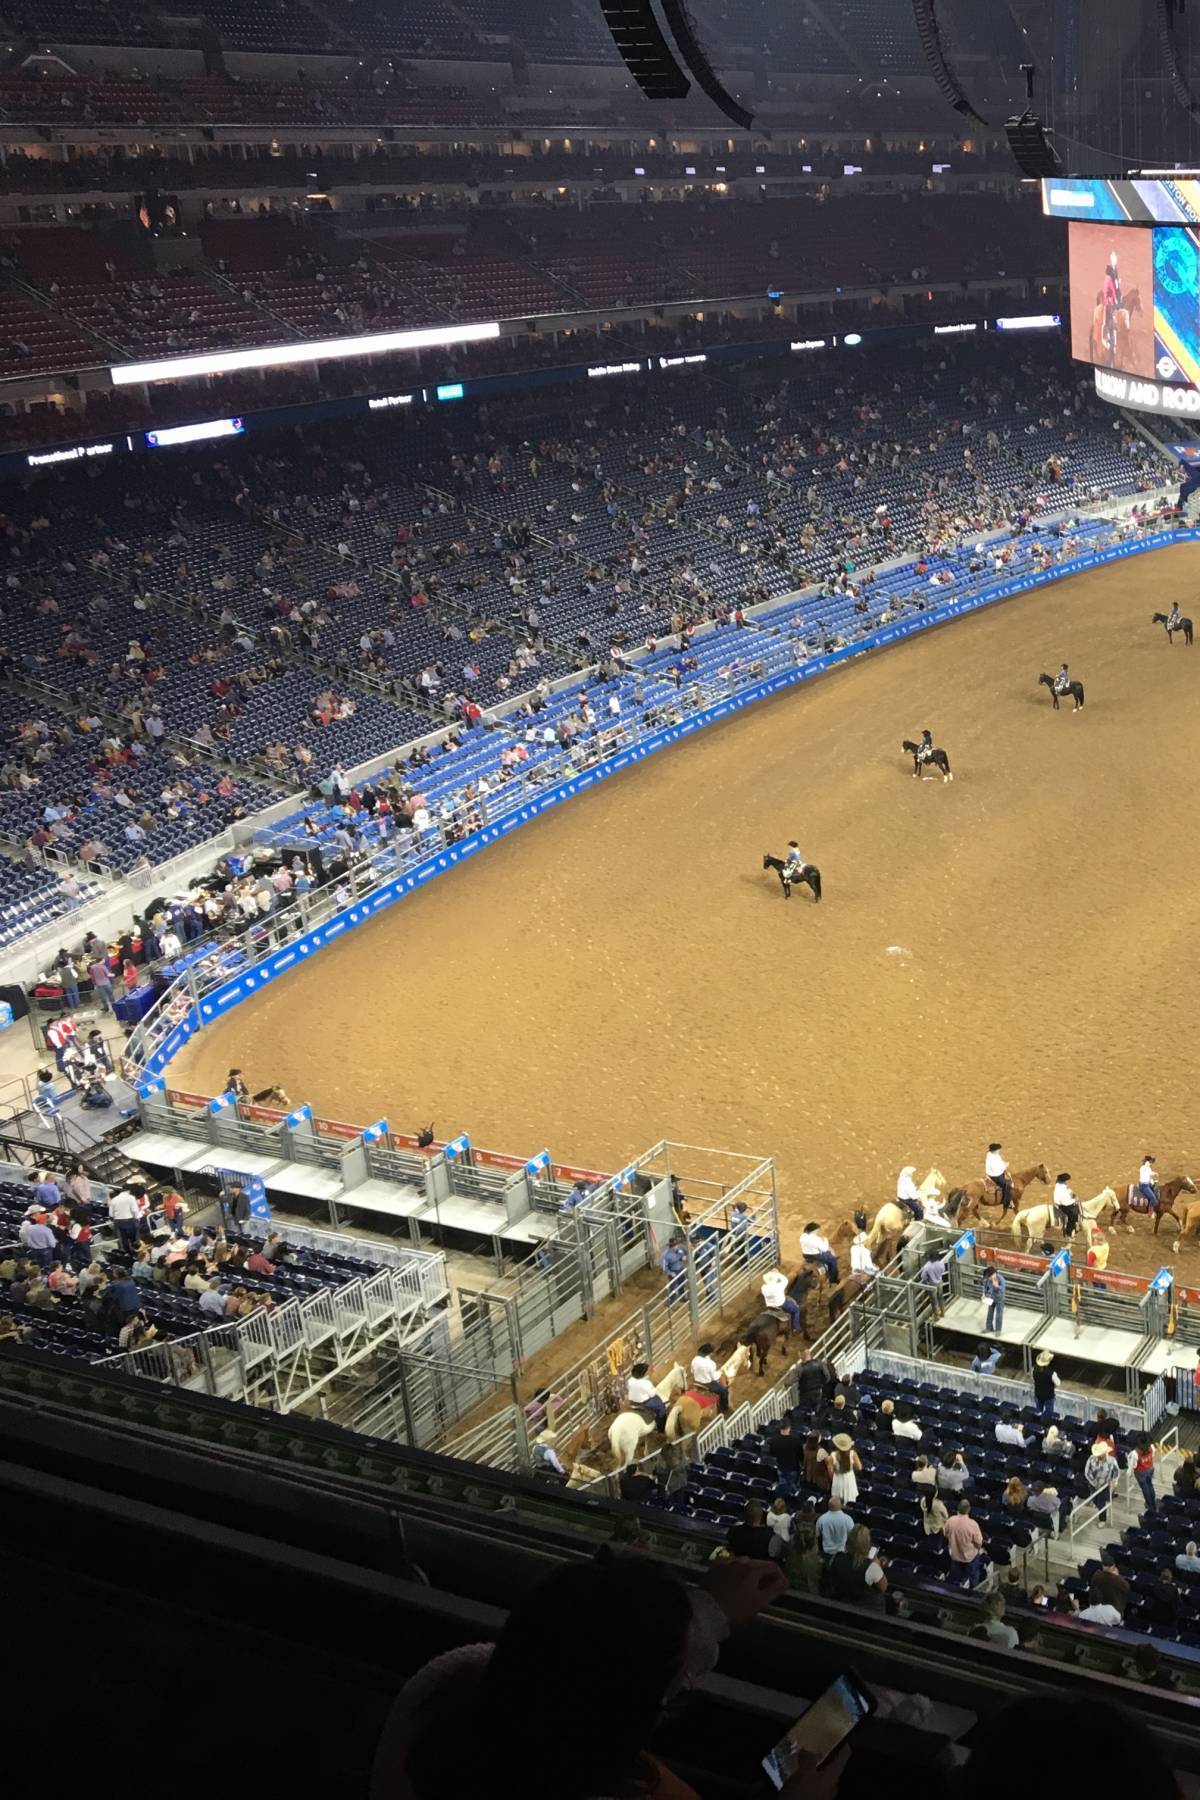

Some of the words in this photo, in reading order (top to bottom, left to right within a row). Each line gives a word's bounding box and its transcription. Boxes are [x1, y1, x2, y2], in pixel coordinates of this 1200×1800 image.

[1128, 381, 1160, 406] AND
[980, 1249, 987, 1259] 6
[1076, 1268, 1083, 1278] 5
[1179, 1289, 1187, 1300] 4
